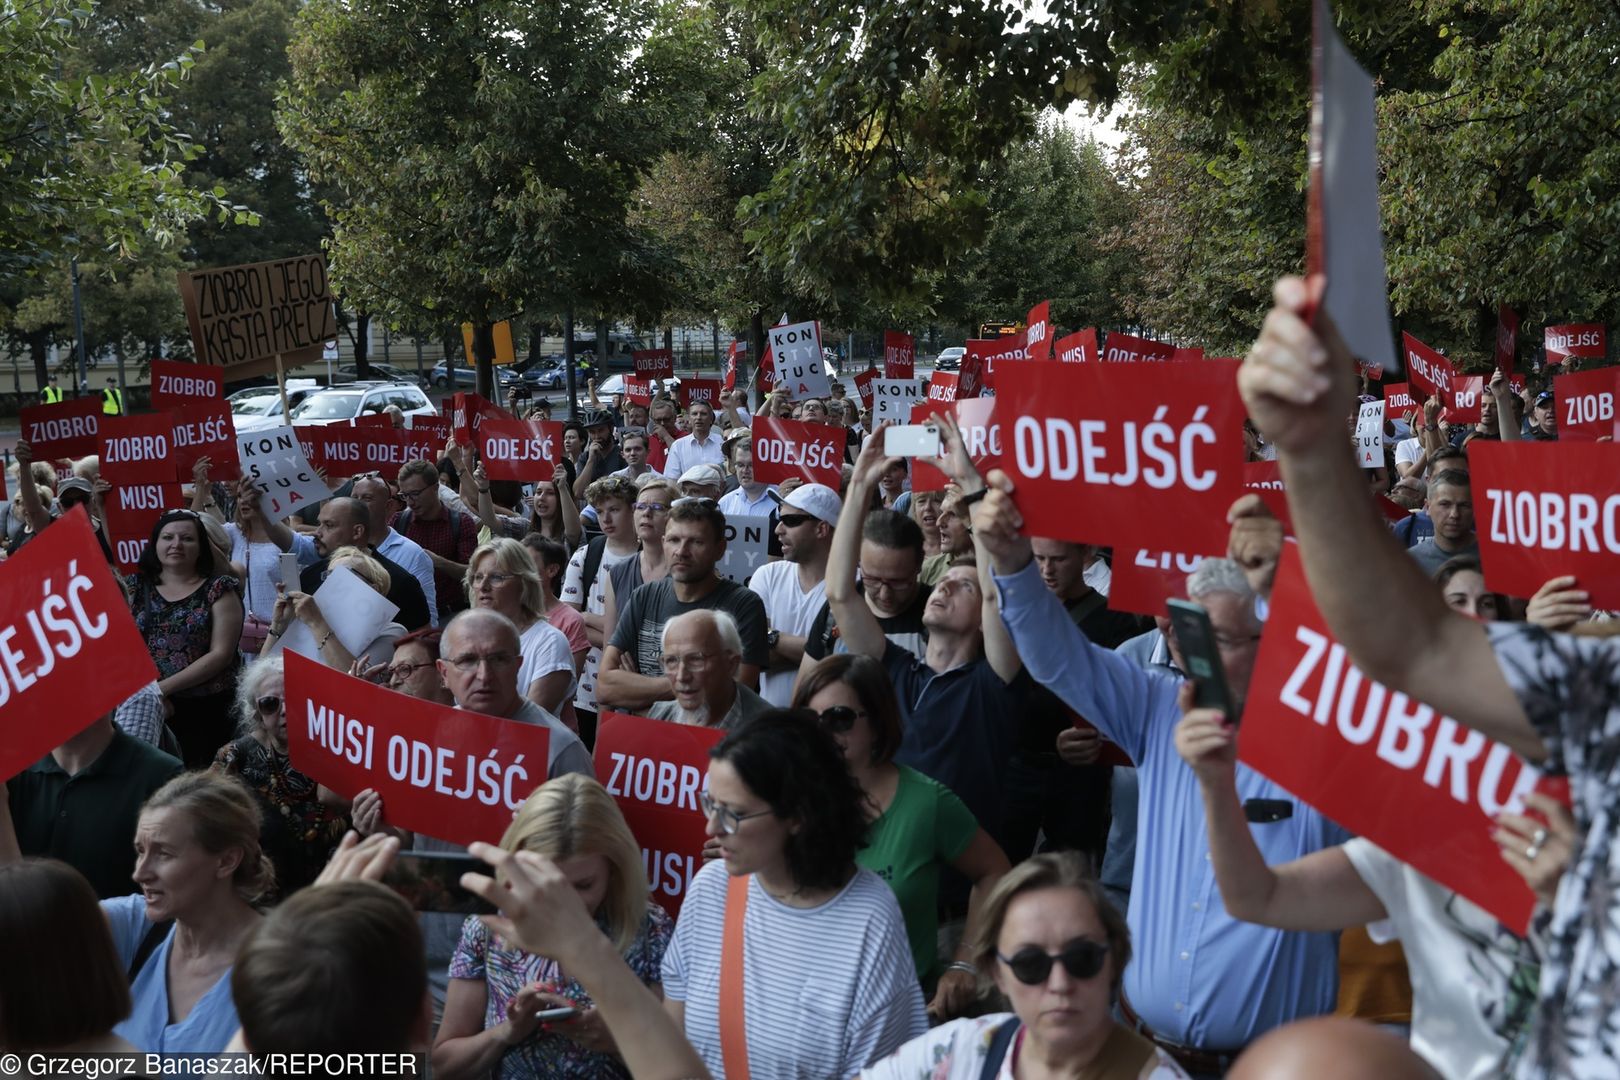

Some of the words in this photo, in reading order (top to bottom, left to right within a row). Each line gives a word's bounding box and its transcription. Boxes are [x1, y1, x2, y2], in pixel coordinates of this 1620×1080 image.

[193, 268, 262, 319] ZIOBRO
[265, 266, 274, 305] I
[274, 257, 325, 304] JEGO
[203, 311, 271, 365] KASTA
[270, 297, 337, 352] PRECZ
[774, 328, 812, 346] KON
[1549, 330, 1600, 350] ODEJŚĆ
[636, 355, 670, 371] ODEJŚĆ
[886, 346, 911, 366] ODEJŚĆ
[780, 363, 819, 380] TUC
[1409, 351, 1450, 393] ODEJŚĆ
[159, 375, 216, 397] ZIOBRO
[688, 388, 712, 400] MUSI
[878, 384, 917, 397] KON
[1565, 392, 1614, 425] ZIOB
[30, 414, 97, 444] ZIOBRO
[940, 424, 1002, 458] BRO
[105, 435, 167, 463] ZIOBRO
[244, 435, 293, 457] KON
[324, 441, 362, 461] MUS
[367, 441, 430, 464] ODEJŚĆ
[486, 435, 553, 461] ODEJŚĆ
[757, 438, 835, 469] ODEJŚĆ
[1014, 405, 1217, 491] ODEJŚĆ
[258, 472, 311, 493] TUC
[119, 485, 164, 510] MUSI
[271, 490, 304, 513] JA
[1280, 626, 1541, 816] ZIOBRO
[306, 698, 375, 771] MUSI
[387, 735, 528, 811] ODEJŚĆ
[606, 752, 710, 811] ZIOBR
